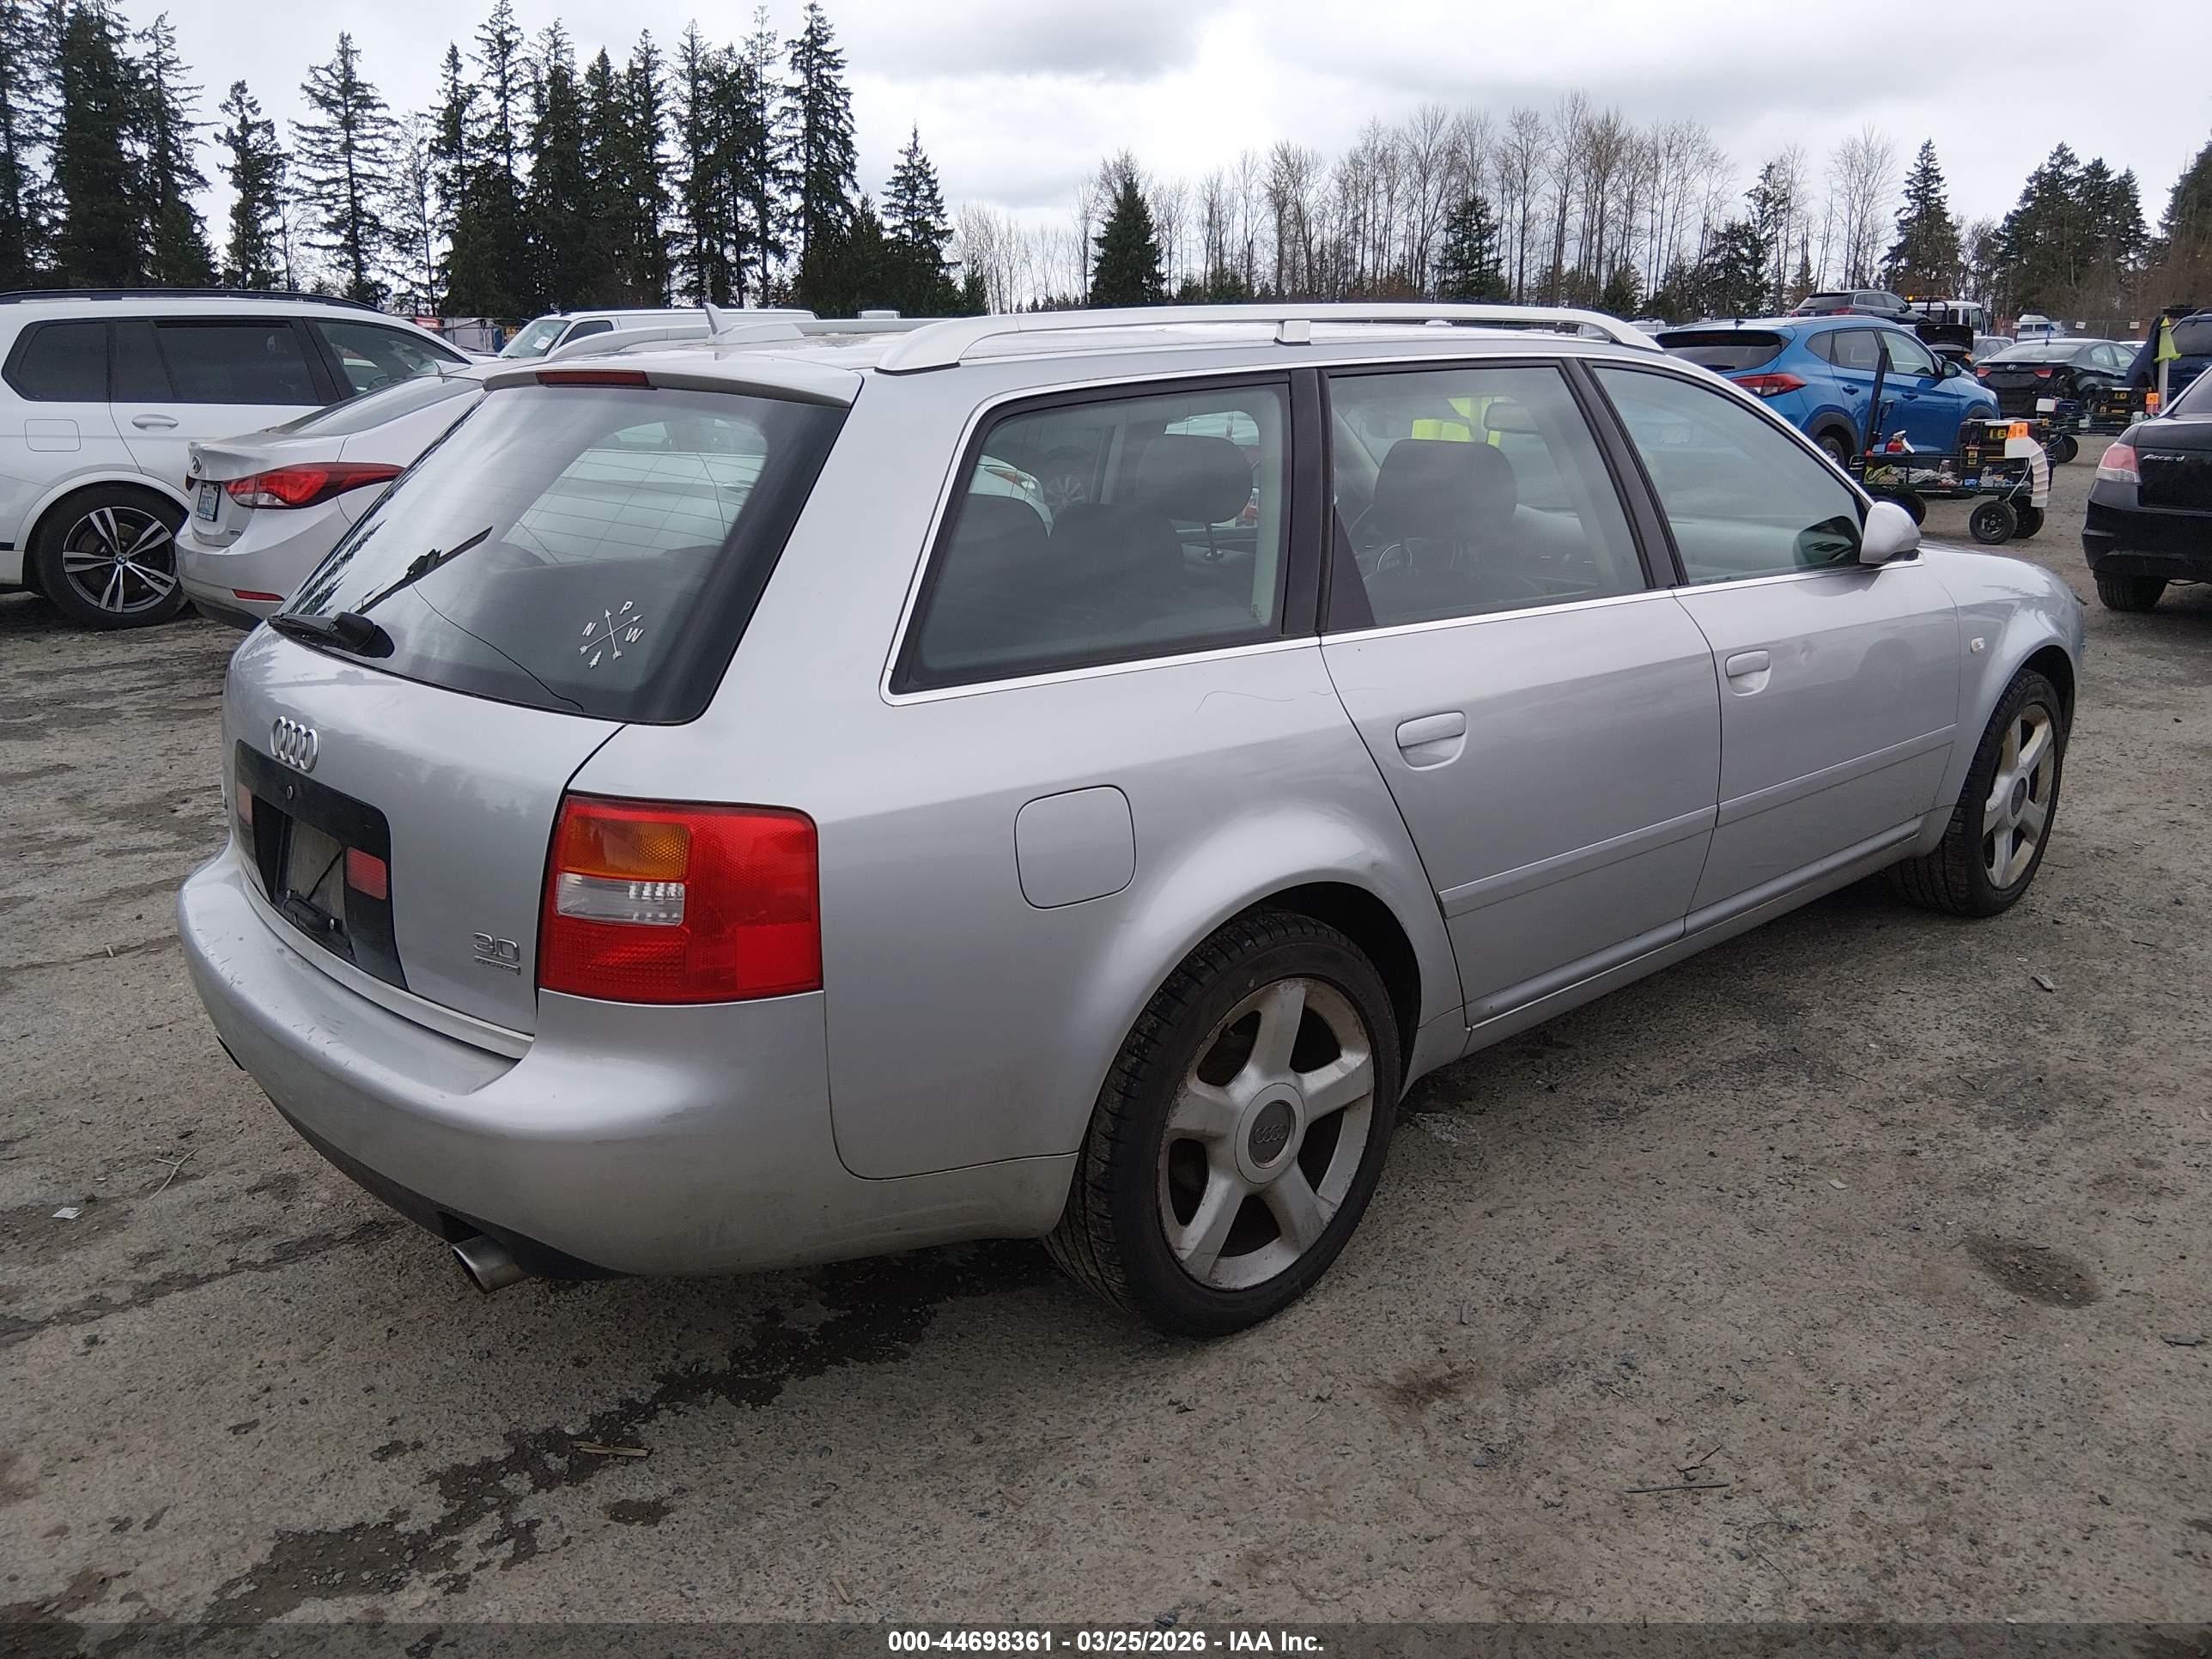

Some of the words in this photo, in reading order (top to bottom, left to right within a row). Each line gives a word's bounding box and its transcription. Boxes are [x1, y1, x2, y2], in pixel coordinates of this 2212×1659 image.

[619, 600, 634, 615] P
[582, 622, 598, 636] N
[624, 627, 644, 643] W
